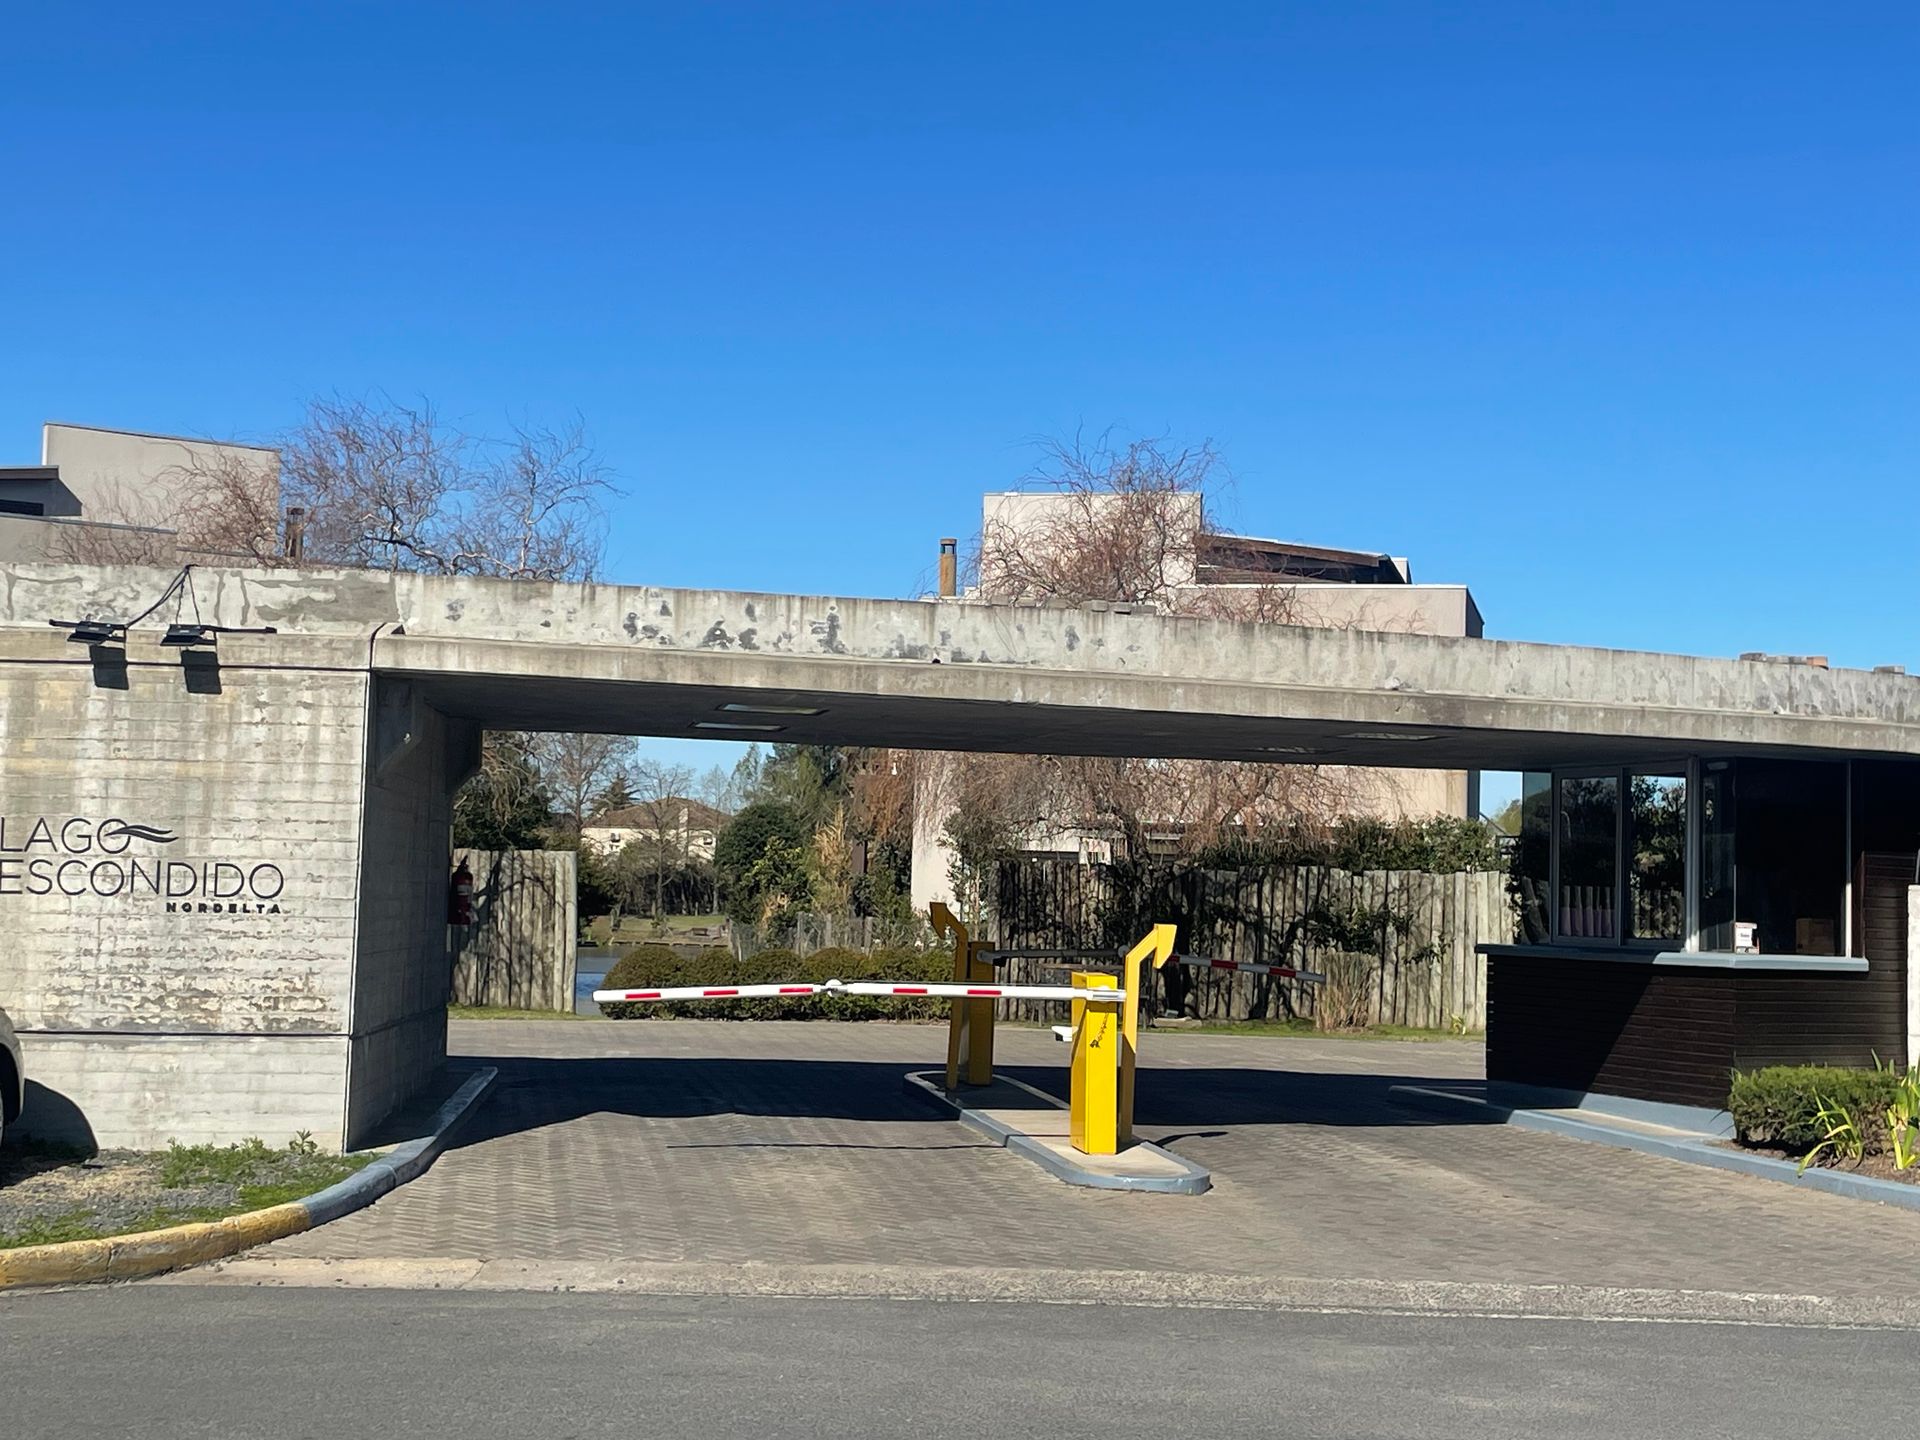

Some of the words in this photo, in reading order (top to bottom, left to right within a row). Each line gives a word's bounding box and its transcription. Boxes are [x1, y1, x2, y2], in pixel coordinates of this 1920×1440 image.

[1, 817, 131, 854] LAGO
[0, 859, 284, 899] ESCONDIDO
[166, 902, 281, 914] NORDELTA
